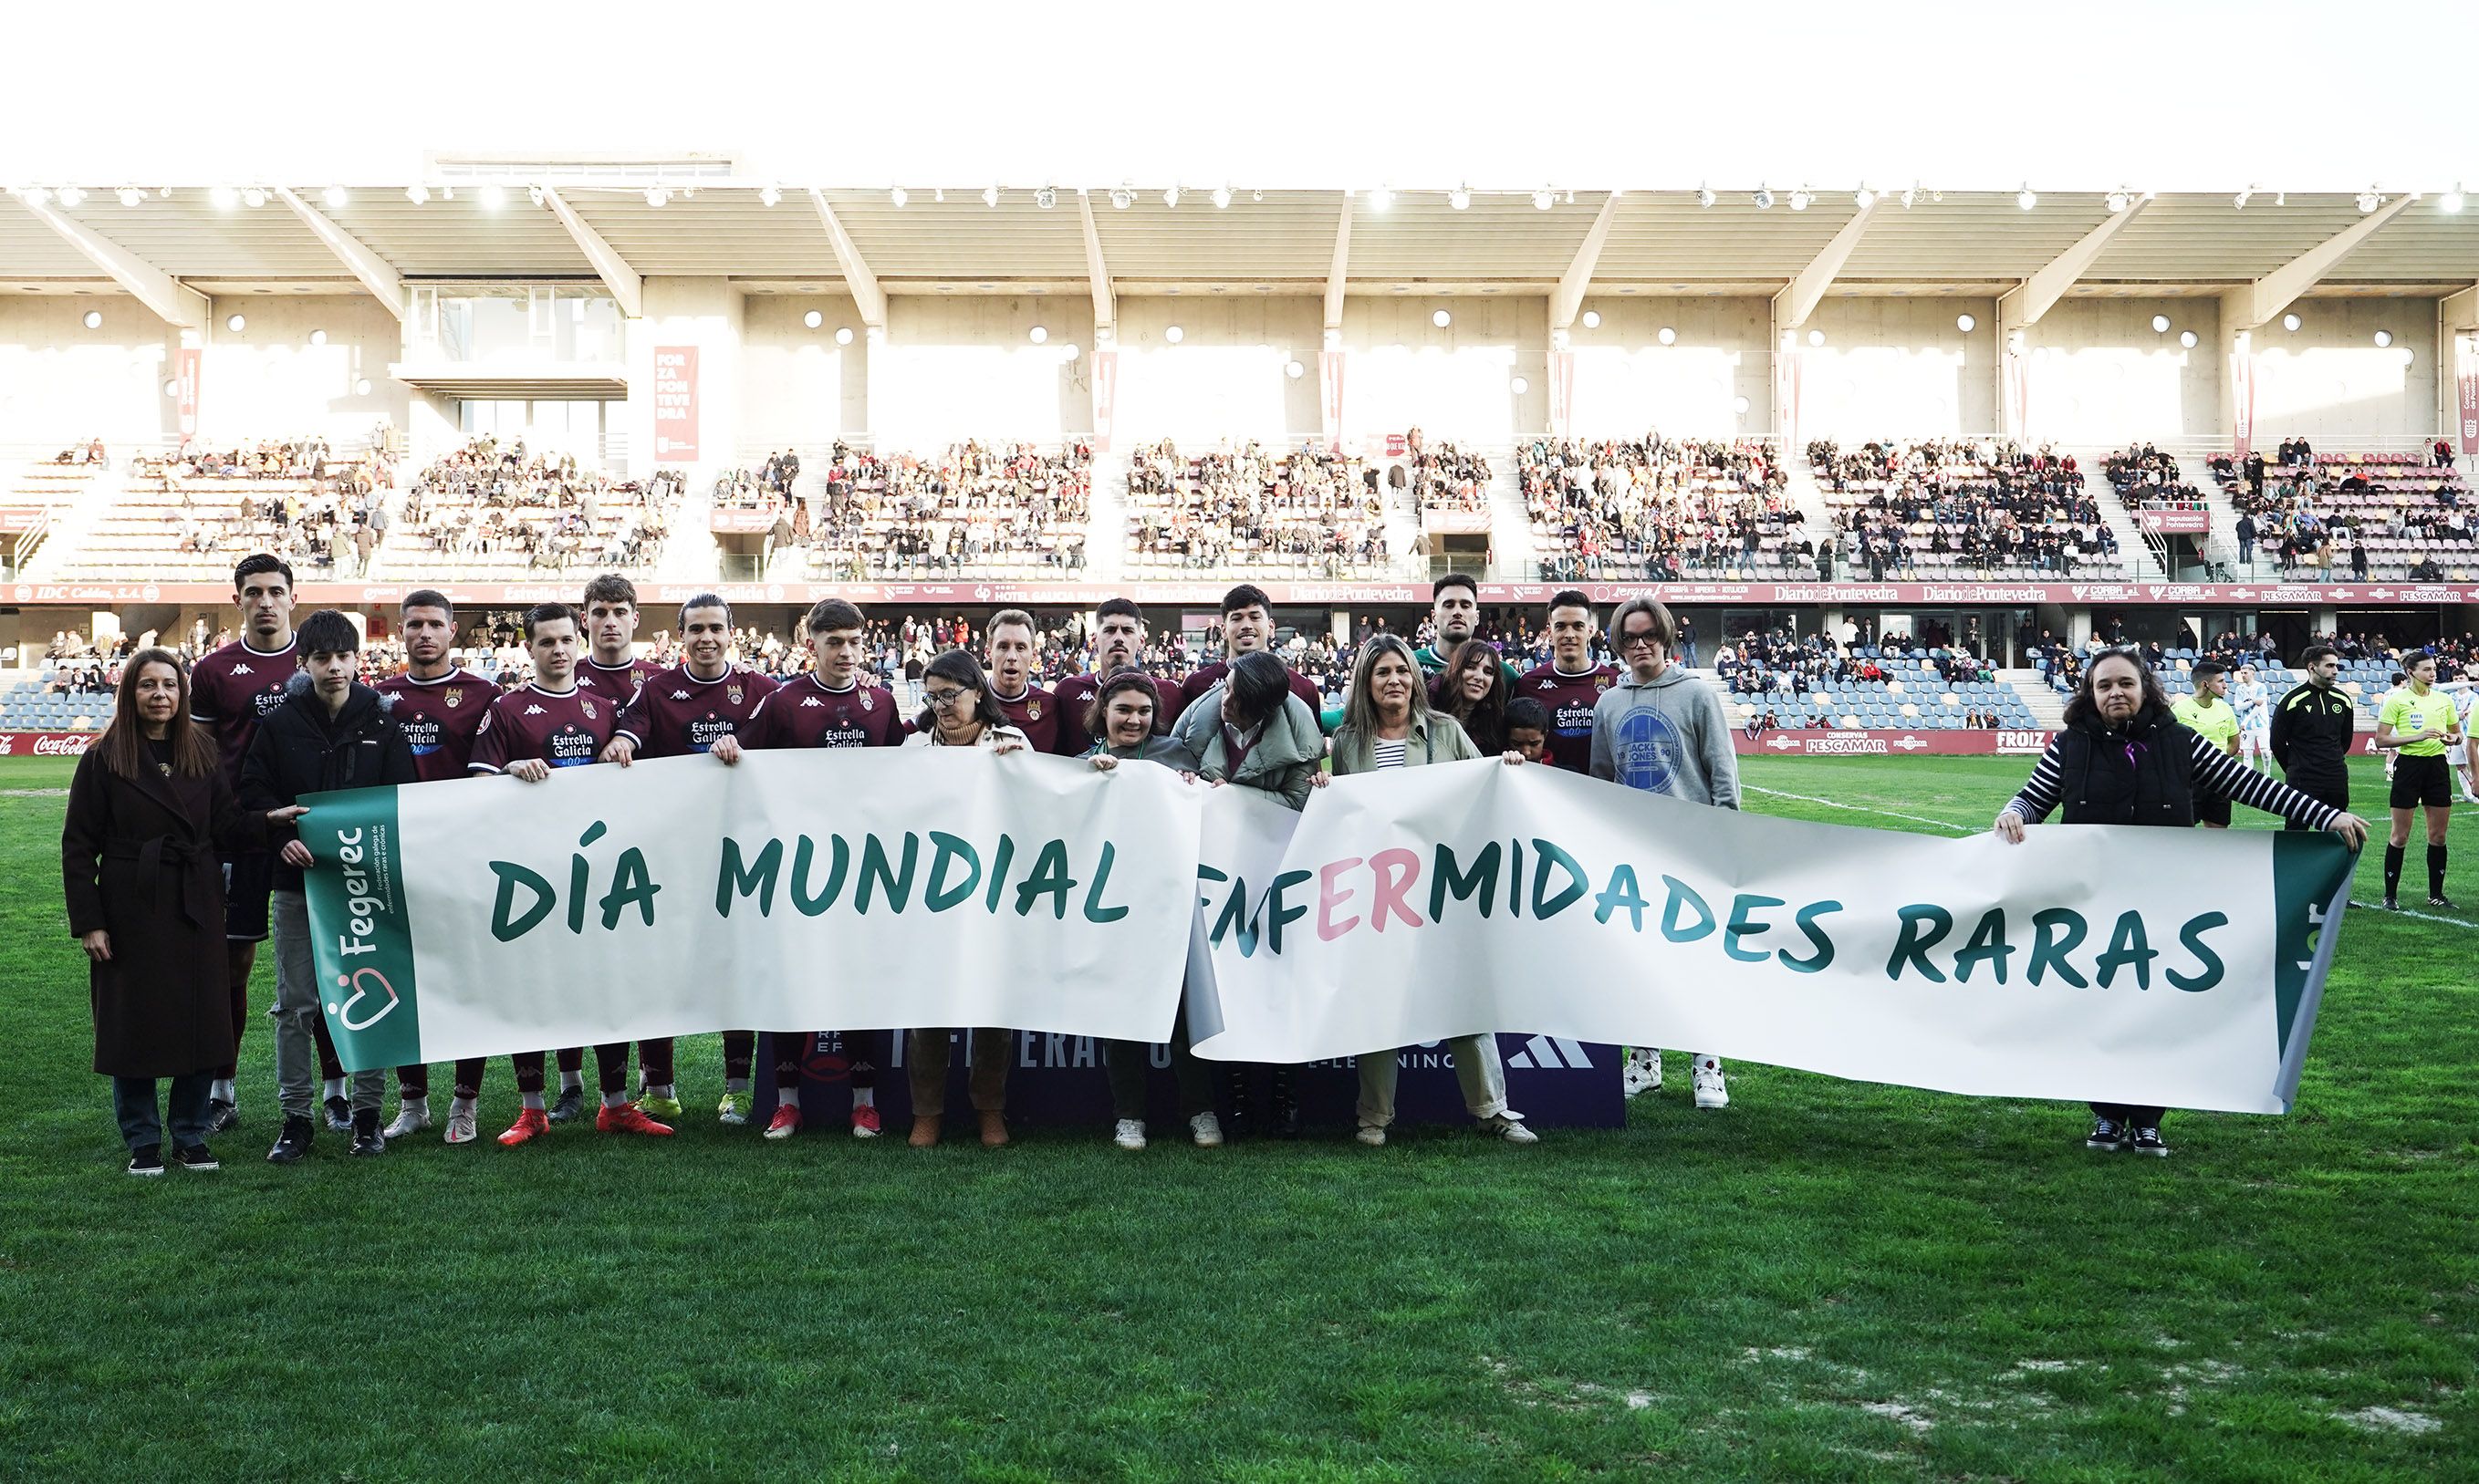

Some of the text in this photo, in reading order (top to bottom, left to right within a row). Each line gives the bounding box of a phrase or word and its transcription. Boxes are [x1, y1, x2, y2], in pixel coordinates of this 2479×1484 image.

[2165, 515, 2204, 524] Deputación
[995, 591, 1030, 601] HOTEL
[2261, 590, 2323, 602] PESCAMAR
[2400, 590, 2462, 602] PESCAMAR
[1556, 707, 1594, 718] Estrella
[692, 721, 734, 732] Estrella
[1557, 716, 1592, 728] Galicia
[404, 732, 436, 744] alicia
[552, 733, 593, 746] Estrella
[825, 729, 865, 741] Estrella
[1826, 732, 1869, 740] CONSERVAS
[1996, 732, 2047, 747] FROIZ
[554, 744, 591, 758] Galicia
[1628, 742, 1656, 752] JACK&
[1660, 748, 1672, 756] 90
[1806, 739, 1889, 753] PESCAMAR
[1628, 752, 1657, 761] JONES
[371, 834, 381, 856] galega
[337, 827, 387, 957] Fegerec
[489, 820, 662, 943] DÍA
[715, 830, 1130, 924] MUNDIAL
[1886, 903, 2230, 993] RARAS
